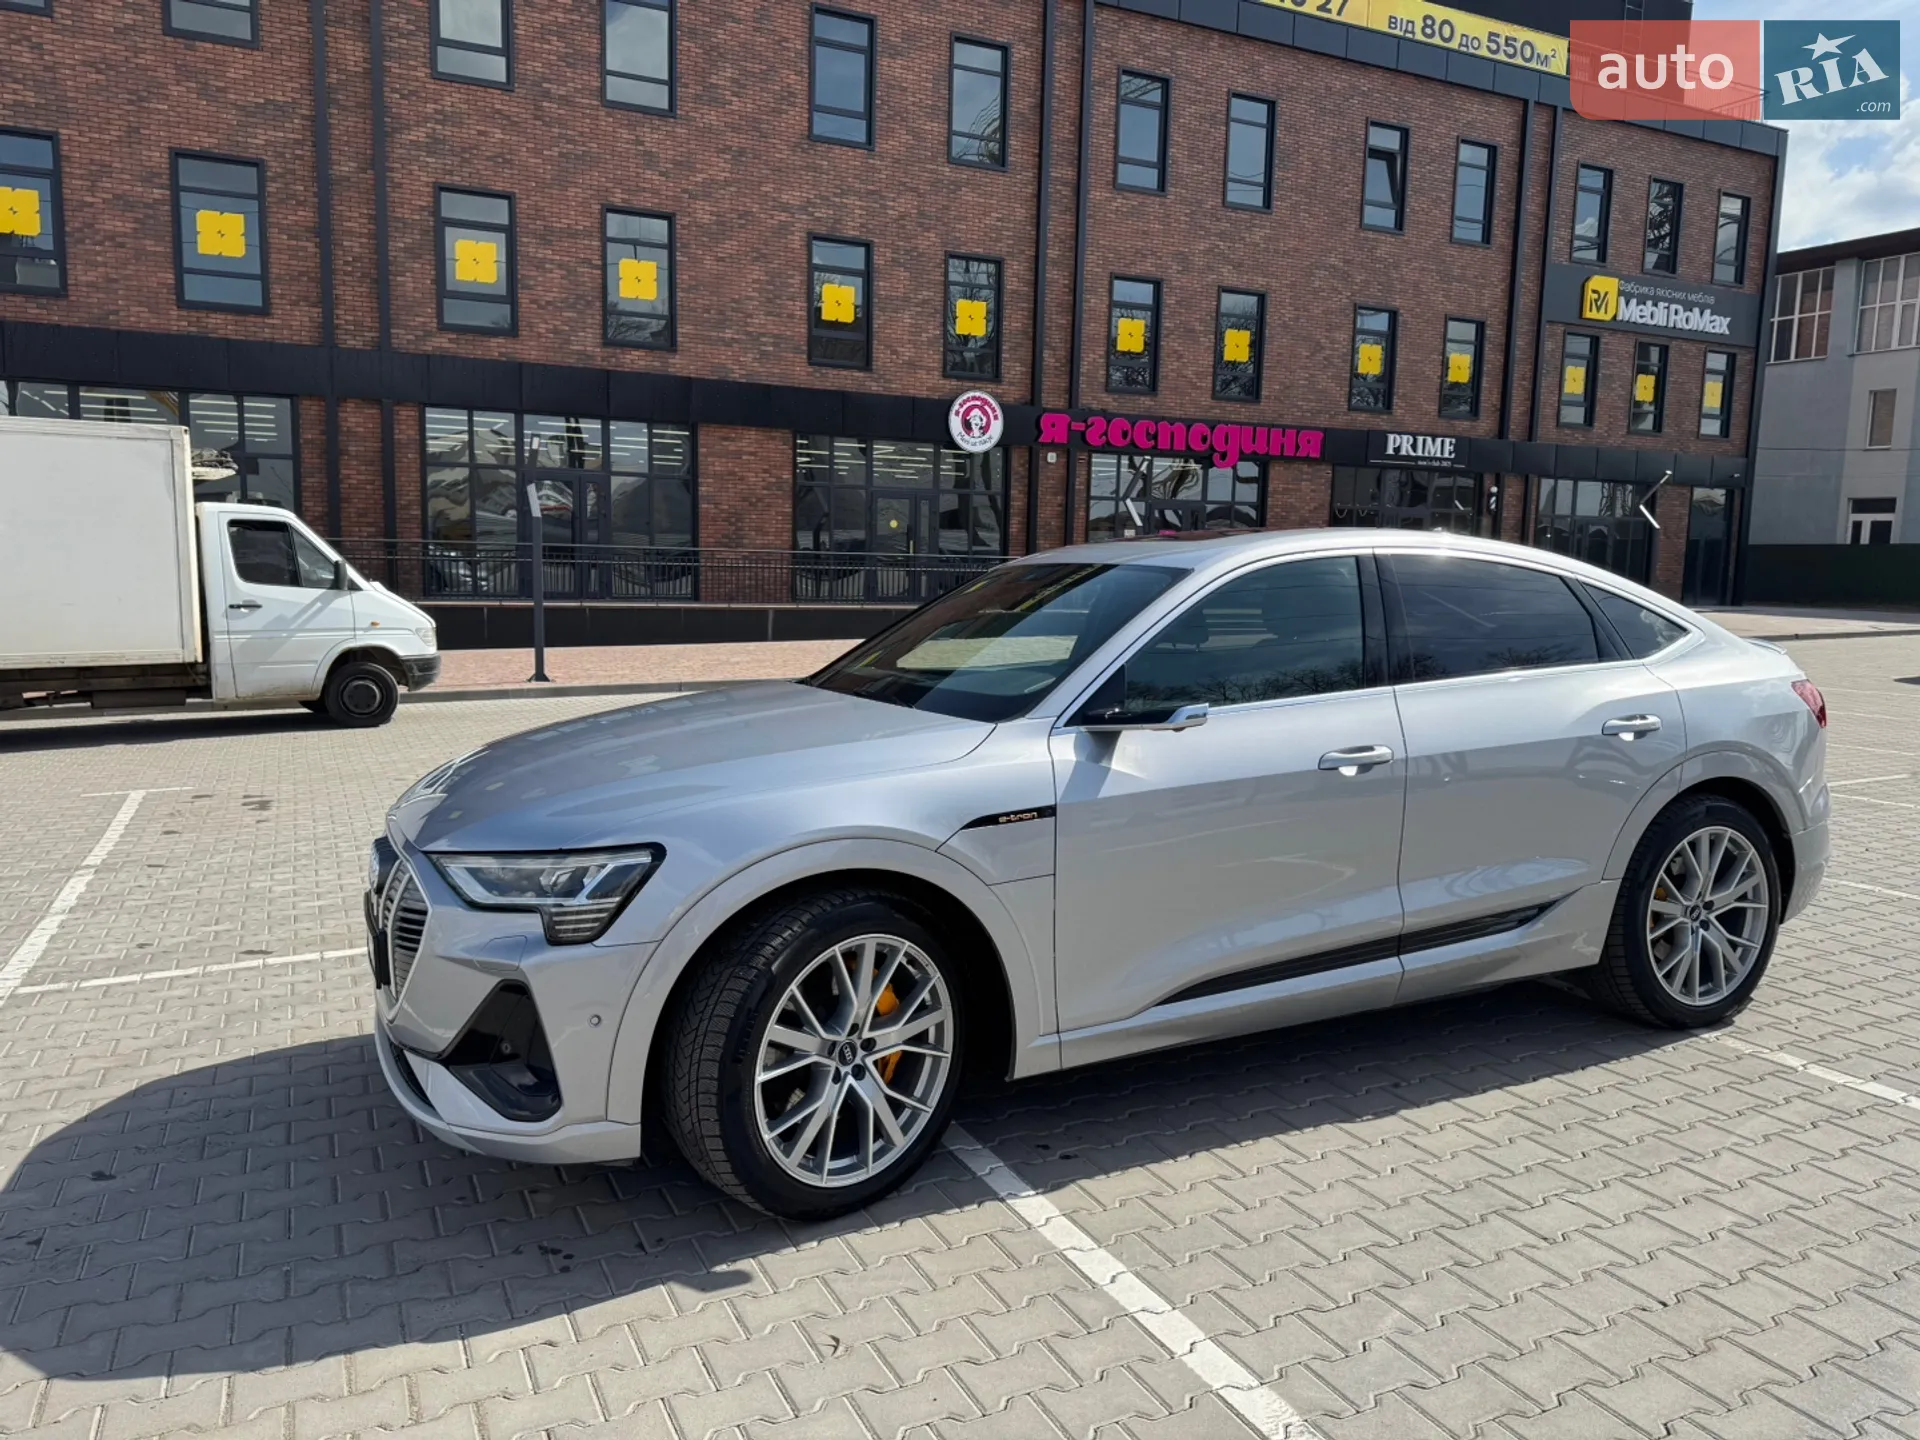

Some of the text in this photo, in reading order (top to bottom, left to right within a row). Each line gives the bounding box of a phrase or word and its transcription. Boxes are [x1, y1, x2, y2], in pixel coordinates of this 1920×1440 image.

[1388, 15, 1416, 39] від
[1421, 14, 1454, 43] 80
[1458, 33, 1481, 51] до
[1619, 280, 1655, 296] Фабрика
[1385, 433, 1456, 459] PRIME
[998, 812, 1038, 823] e-tron
